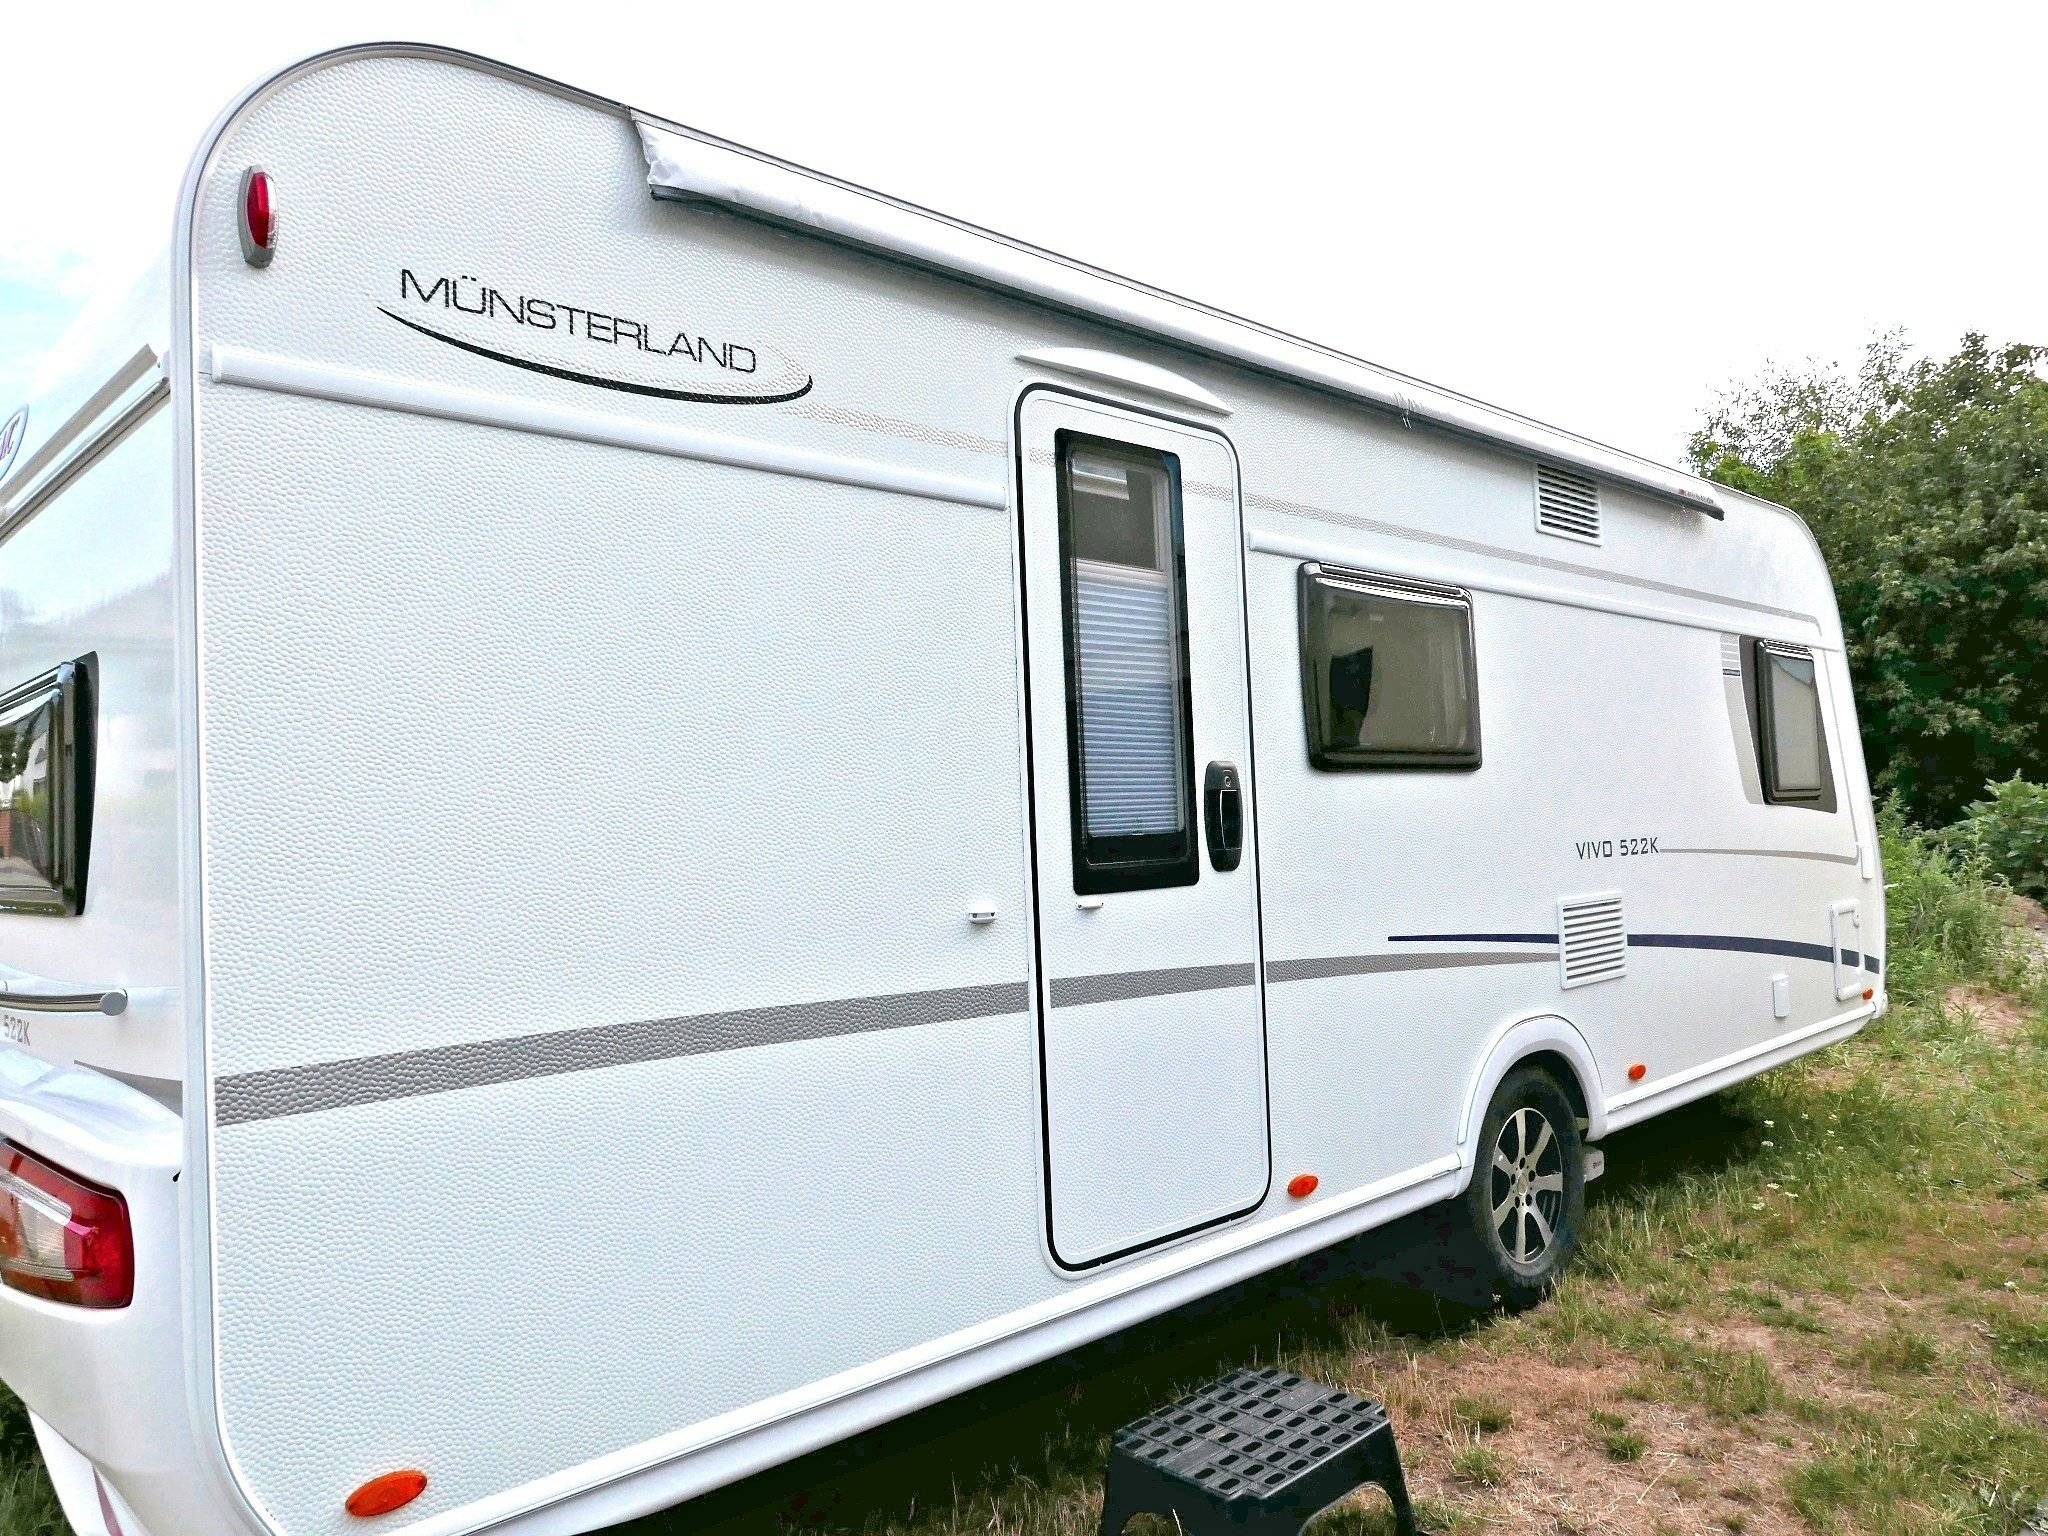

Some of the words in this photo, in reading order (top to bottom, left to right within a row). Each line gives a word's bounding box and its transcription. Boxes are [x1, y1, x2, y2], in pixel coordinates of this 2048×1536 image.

[401, 268, 757, 374] MÜNSTERLAND
[1575, 840, 1612, 860] VIVO
[1620, 837, 1659, 856] 522K
[4, 1014, 31, 1046] 522K
